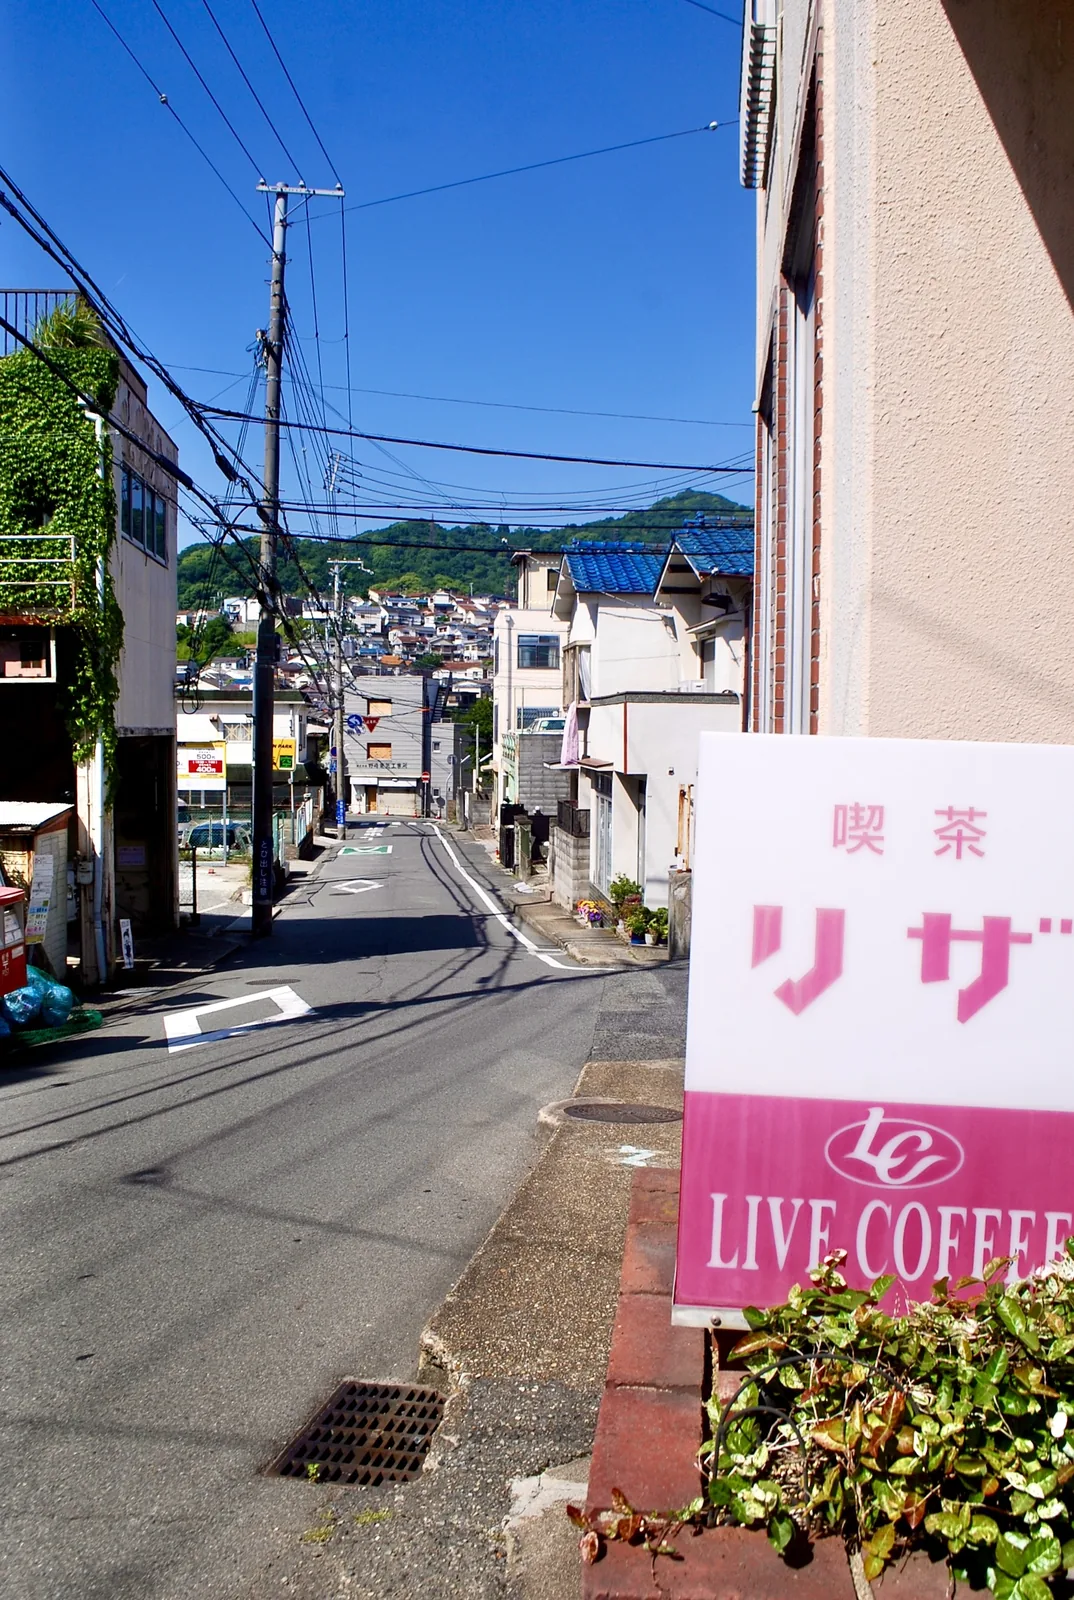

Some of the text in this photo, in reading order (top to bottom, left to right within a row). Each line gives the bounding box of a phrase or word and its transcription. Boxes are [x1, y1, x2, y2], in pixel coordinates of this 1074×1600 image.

[832, 802, 988, 860] 喫茶
[706, 1192, 1074, 1287] LIVE COFFEE
